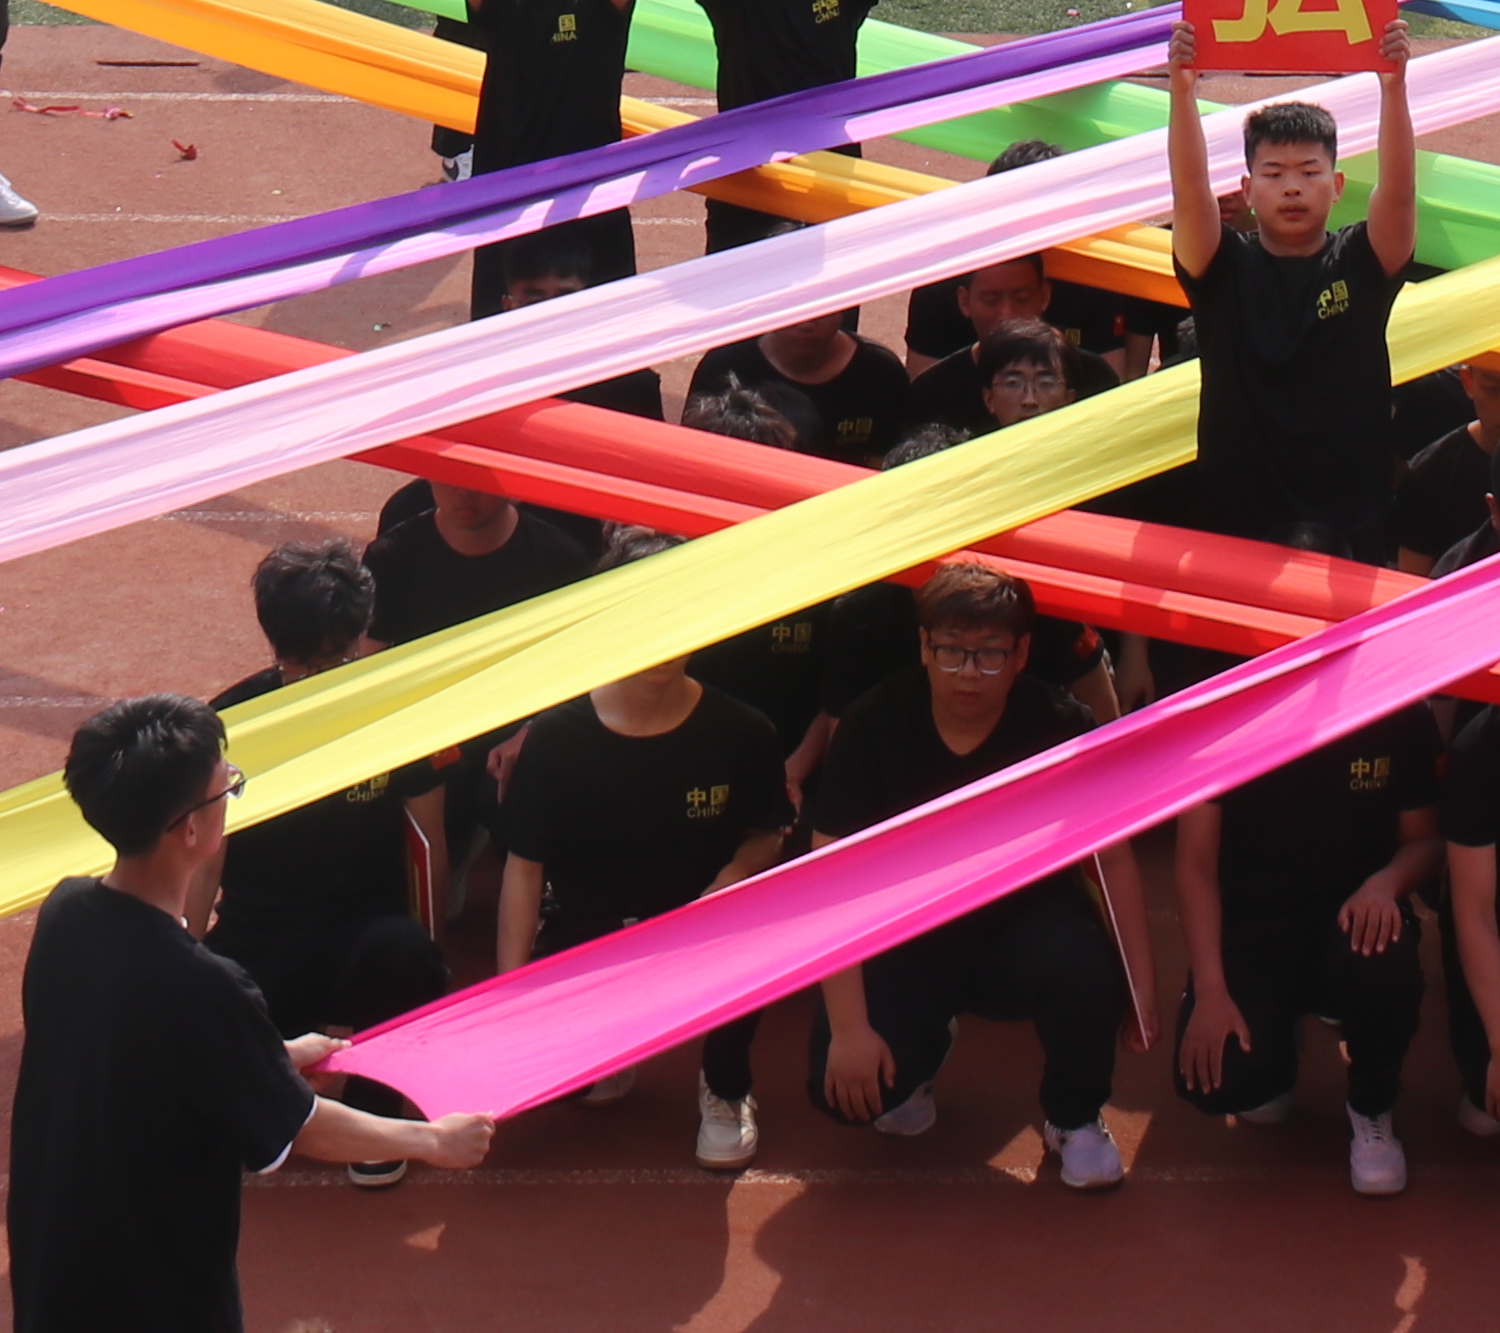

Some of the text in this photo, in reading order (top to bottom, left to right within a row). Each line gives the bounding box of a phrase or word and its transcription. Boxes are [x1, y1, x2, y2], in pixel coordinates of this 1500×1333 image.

[1316, 279, 1349, 308] 中国
[836, 418, 873, 435] 中国
[1350, 756, 1391, 780] 中国
[686, 784, 730, 808] 中国
